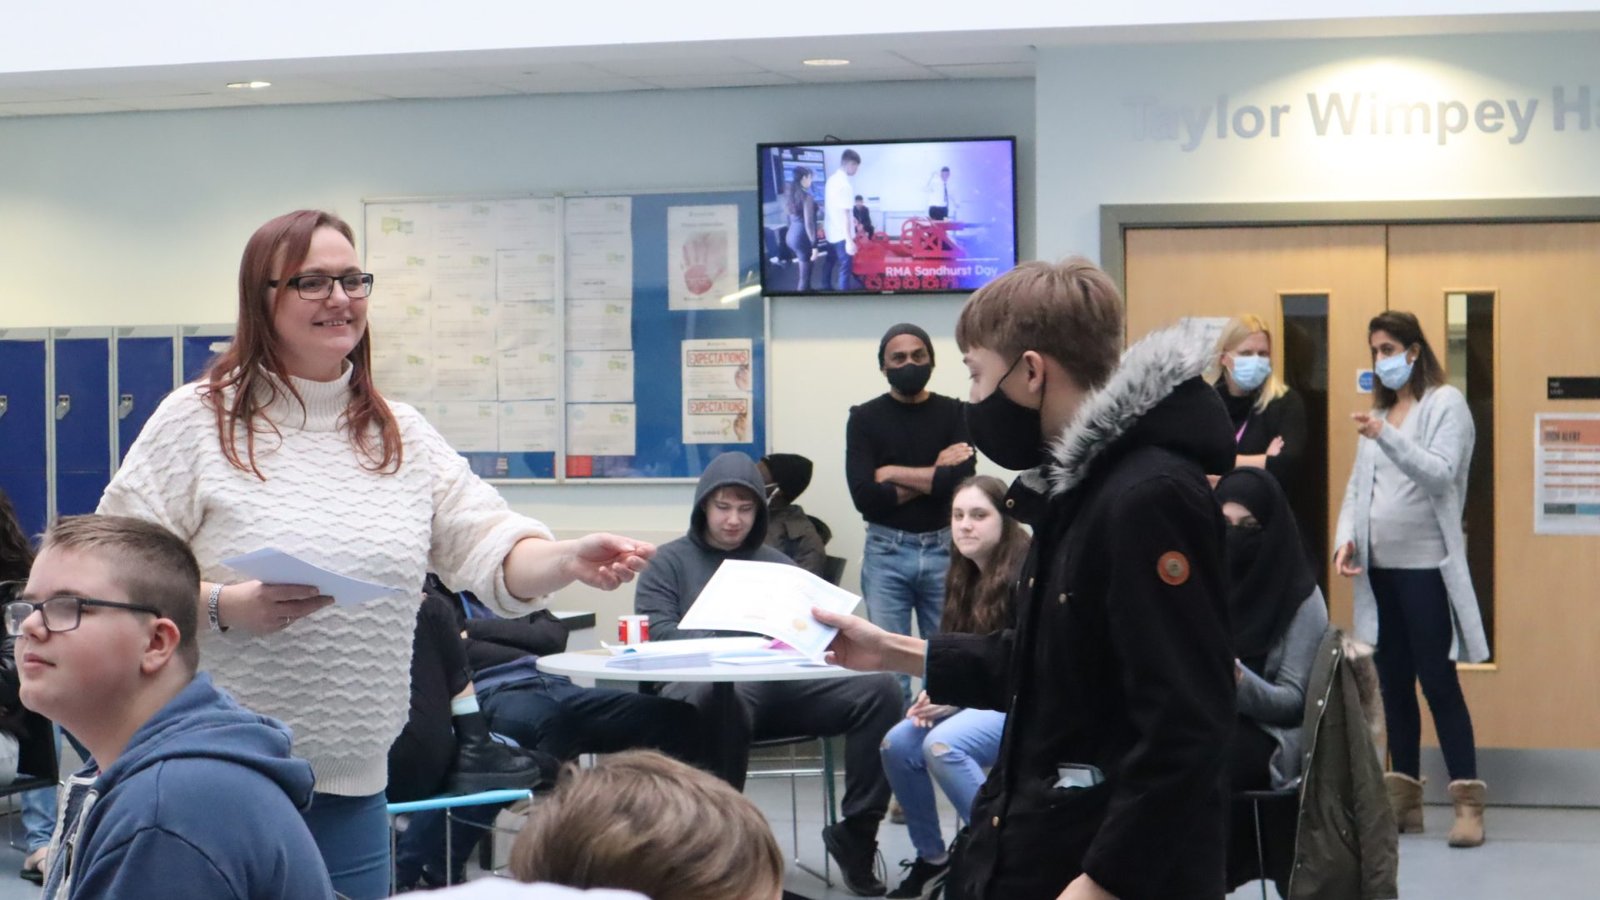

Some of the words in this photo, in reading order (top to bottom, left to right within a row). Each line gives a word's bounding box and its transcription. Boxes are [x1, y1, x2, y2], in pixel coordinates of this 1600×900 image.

[1119, 94, 1291, 152] Taylor
[1306, 92, 1540, 146] Wimpey
[1552, 85, 1600, 131] H
[885, 266, 912, 276] RMA
[914, 265, 972, 276] Sandhurst
[974, 265, 998, 276] Day
[689, 352, 747, 364] EXPECTATIONS
[689, 401, 746, 412] EXPECTATIONS
